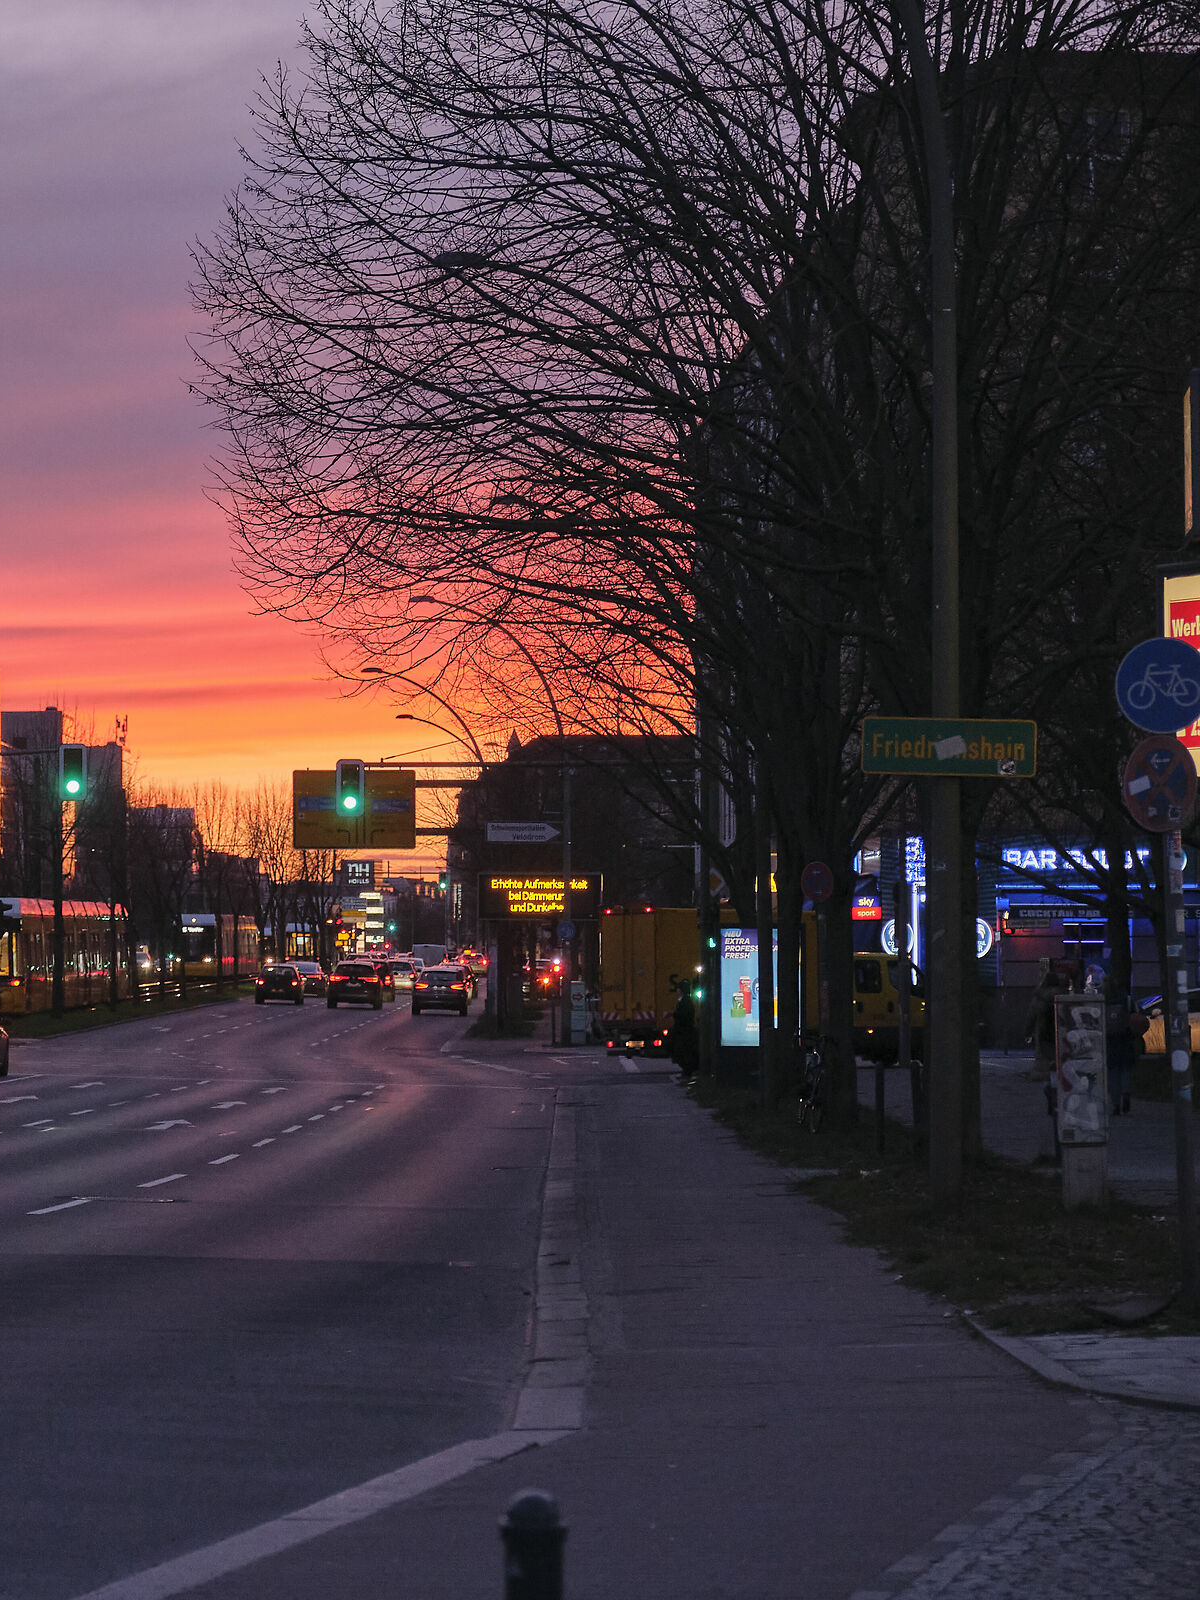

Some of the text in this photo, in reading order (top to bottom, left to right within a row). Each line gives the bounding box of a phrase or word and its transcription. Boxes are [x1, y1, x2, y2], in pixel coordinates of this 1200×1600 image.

[872, 733, 1025, 761] Friedrshain
[1006, 850, 1058, 869] BAR
[491, 879, 588, 889] Erhöhte Aufmerksakeit
[508, 891, 565, 901] bei Dämmeru
[510, 902, 565, 912] und Dunkelhe
[858, 897, 875, 908] sky
[857, 910, 876, 918] sport
[724, 930, 742, 938] NEU
[724, 937, 751, 945] EXTRA
